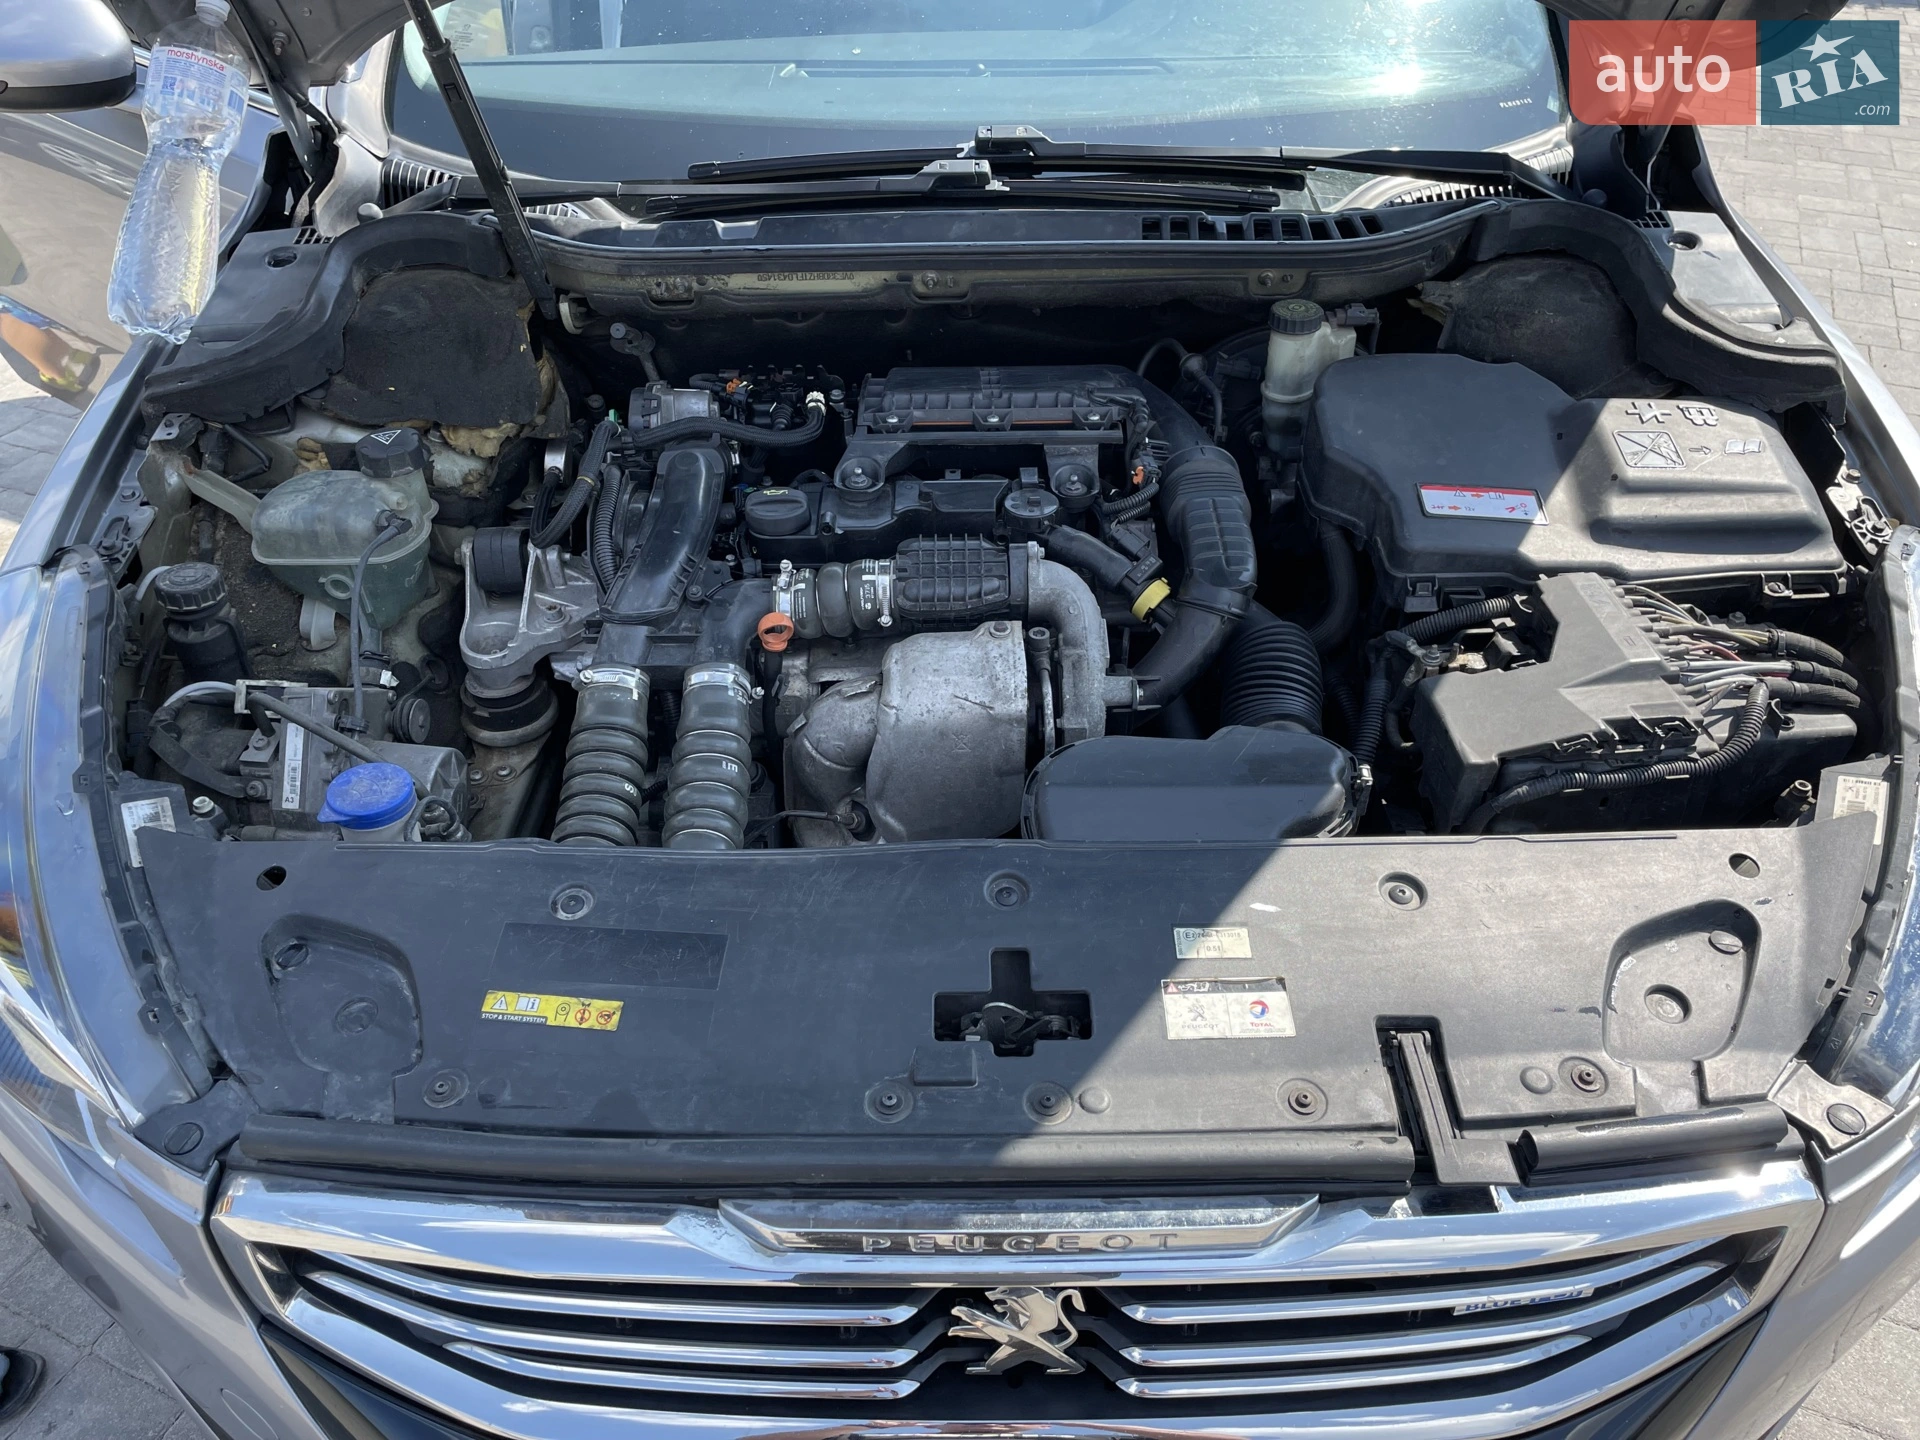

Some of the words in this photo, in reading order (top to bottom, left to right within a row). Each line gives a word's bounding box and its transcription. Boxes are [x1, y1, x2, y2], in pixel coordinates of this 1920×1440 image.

[167, 49, 225, 72] morshynska
[503, 1014, 522, 1022] START
[522, 1015, 547, 1024] SYSTEM
[863, 1233, 1178, 1253] PEUGEOT
